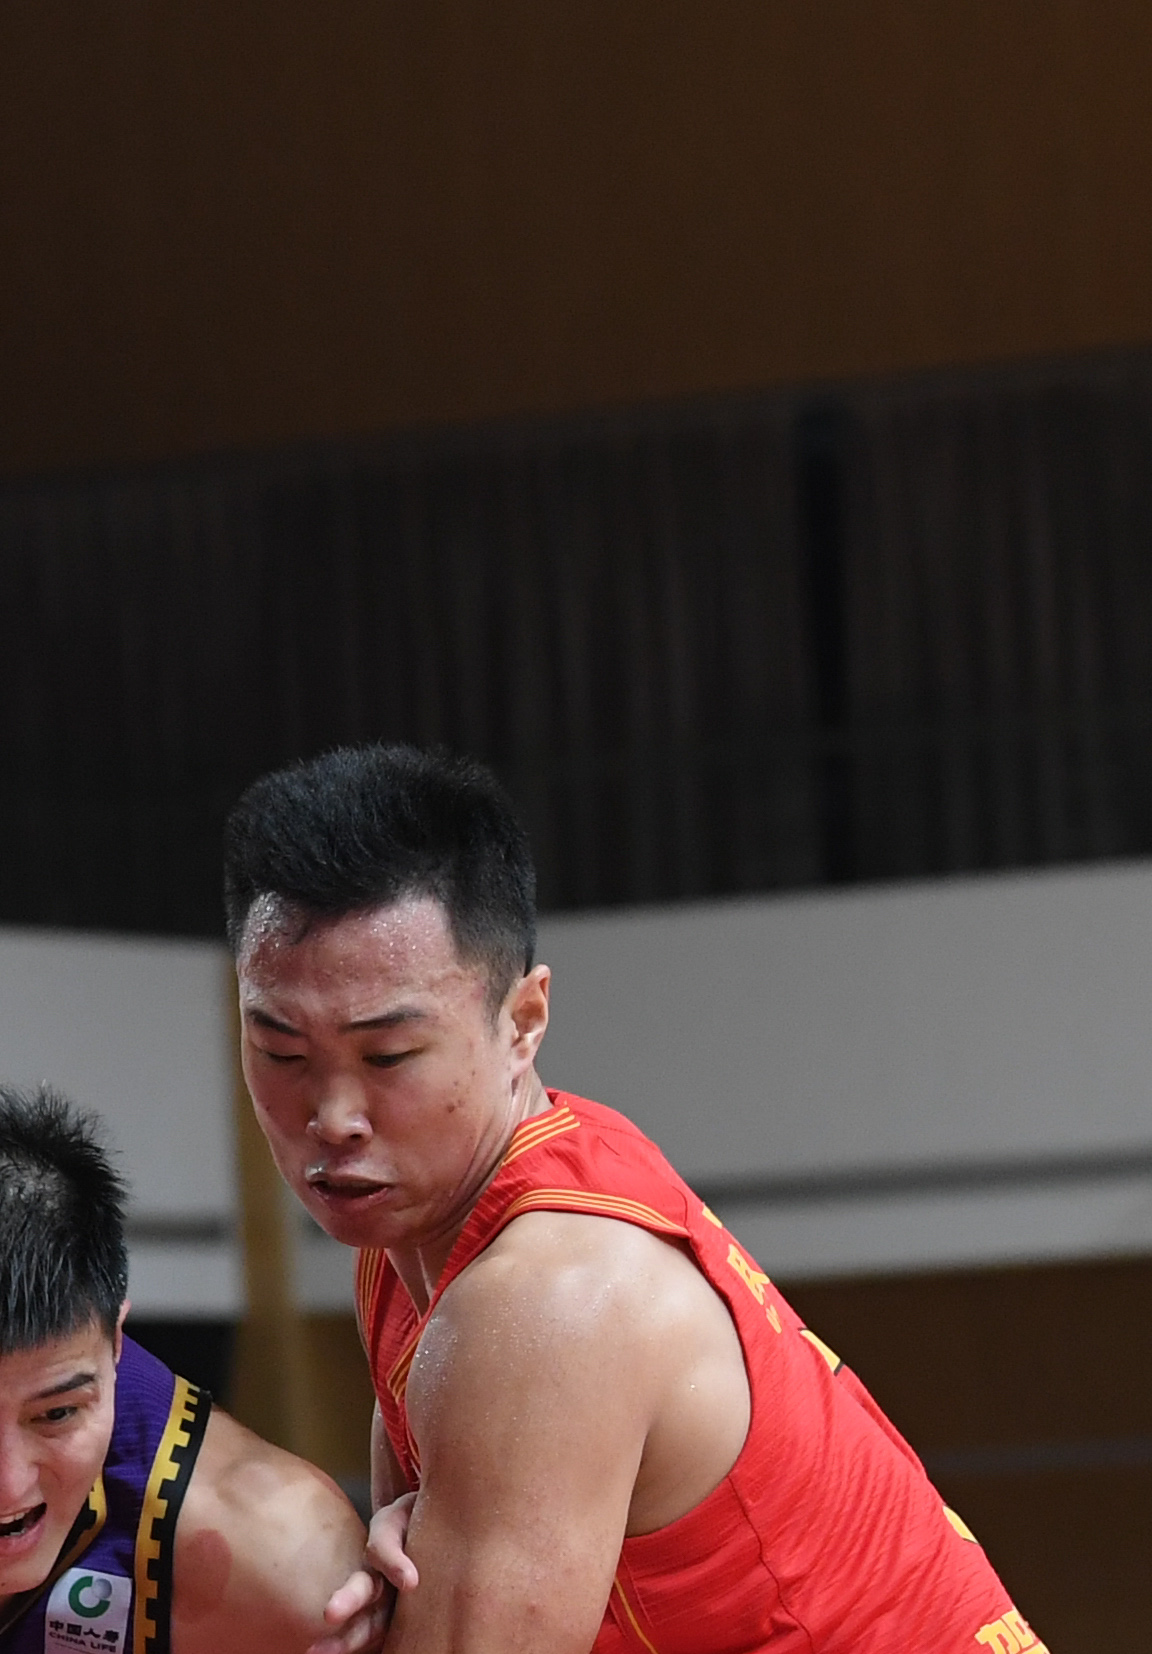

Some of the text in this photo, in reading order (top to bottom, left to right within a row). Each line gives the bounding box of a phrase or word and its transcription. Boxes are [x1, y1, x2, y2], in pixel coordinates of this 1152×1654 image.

[48, 1631, 117, 1653] CHINA LIFE
[49, 1620, 120, 1644] 中国人寿
